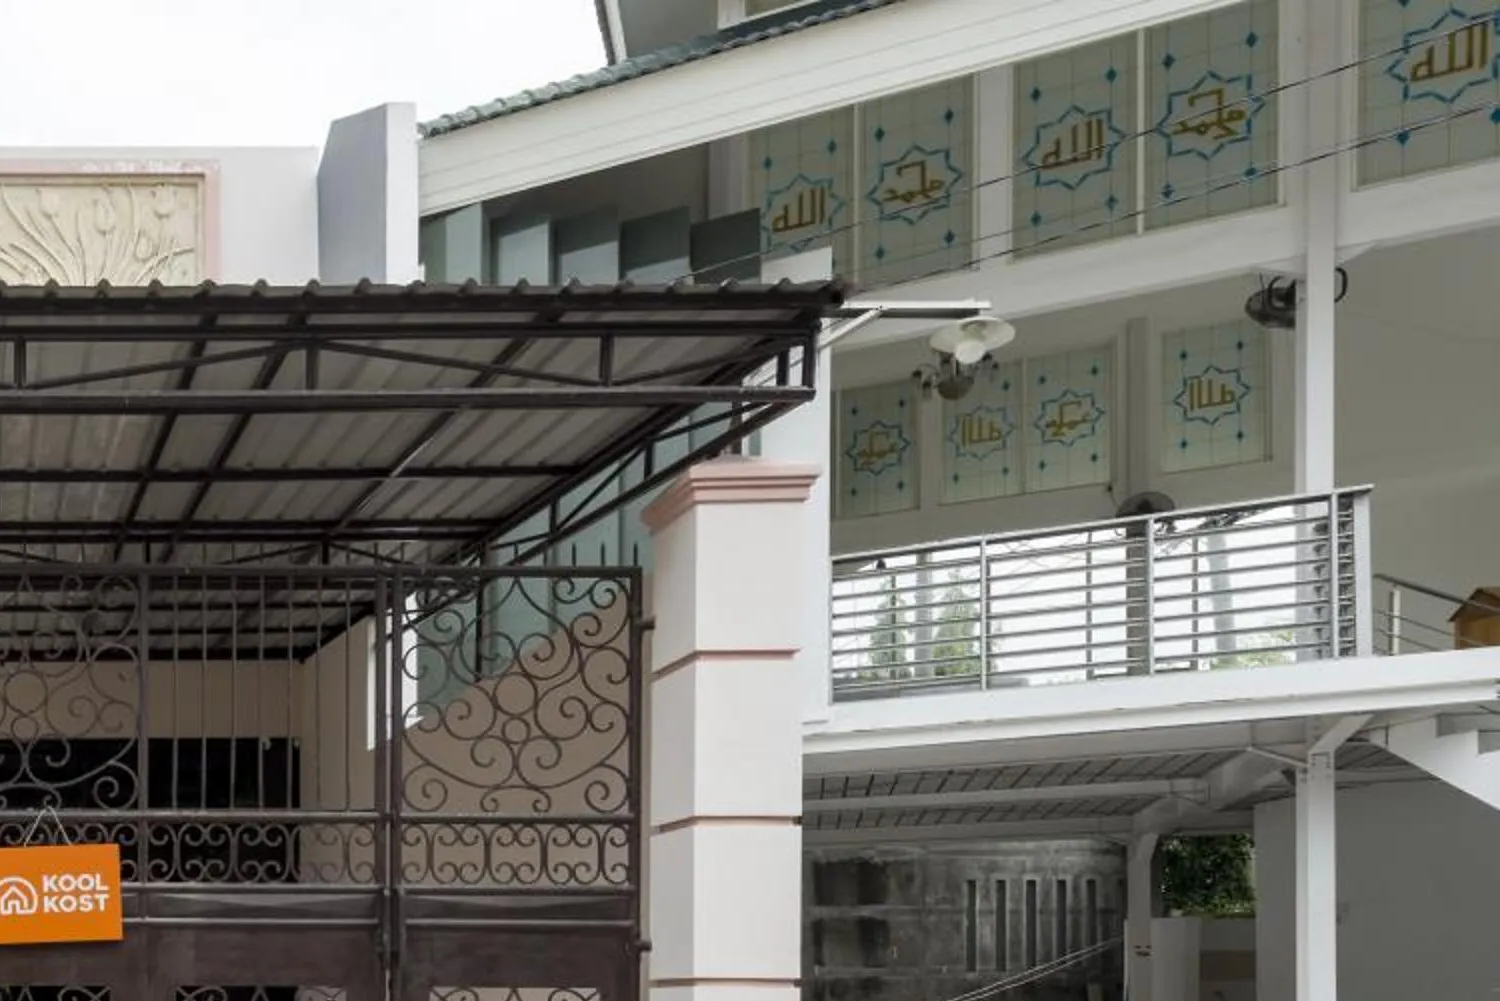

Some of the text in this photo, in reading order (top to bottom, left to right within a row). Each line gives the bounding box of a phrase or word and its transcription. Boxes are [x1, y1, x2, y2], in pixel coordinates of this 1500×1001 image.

[1411, 21, 1488, 82] الله
[1041, 118, 1104, 170] الله
[772, 186, 825, 232] الله
[42, 873, 109, 892] KOOL
[43, 894, 109, 913] KOST
